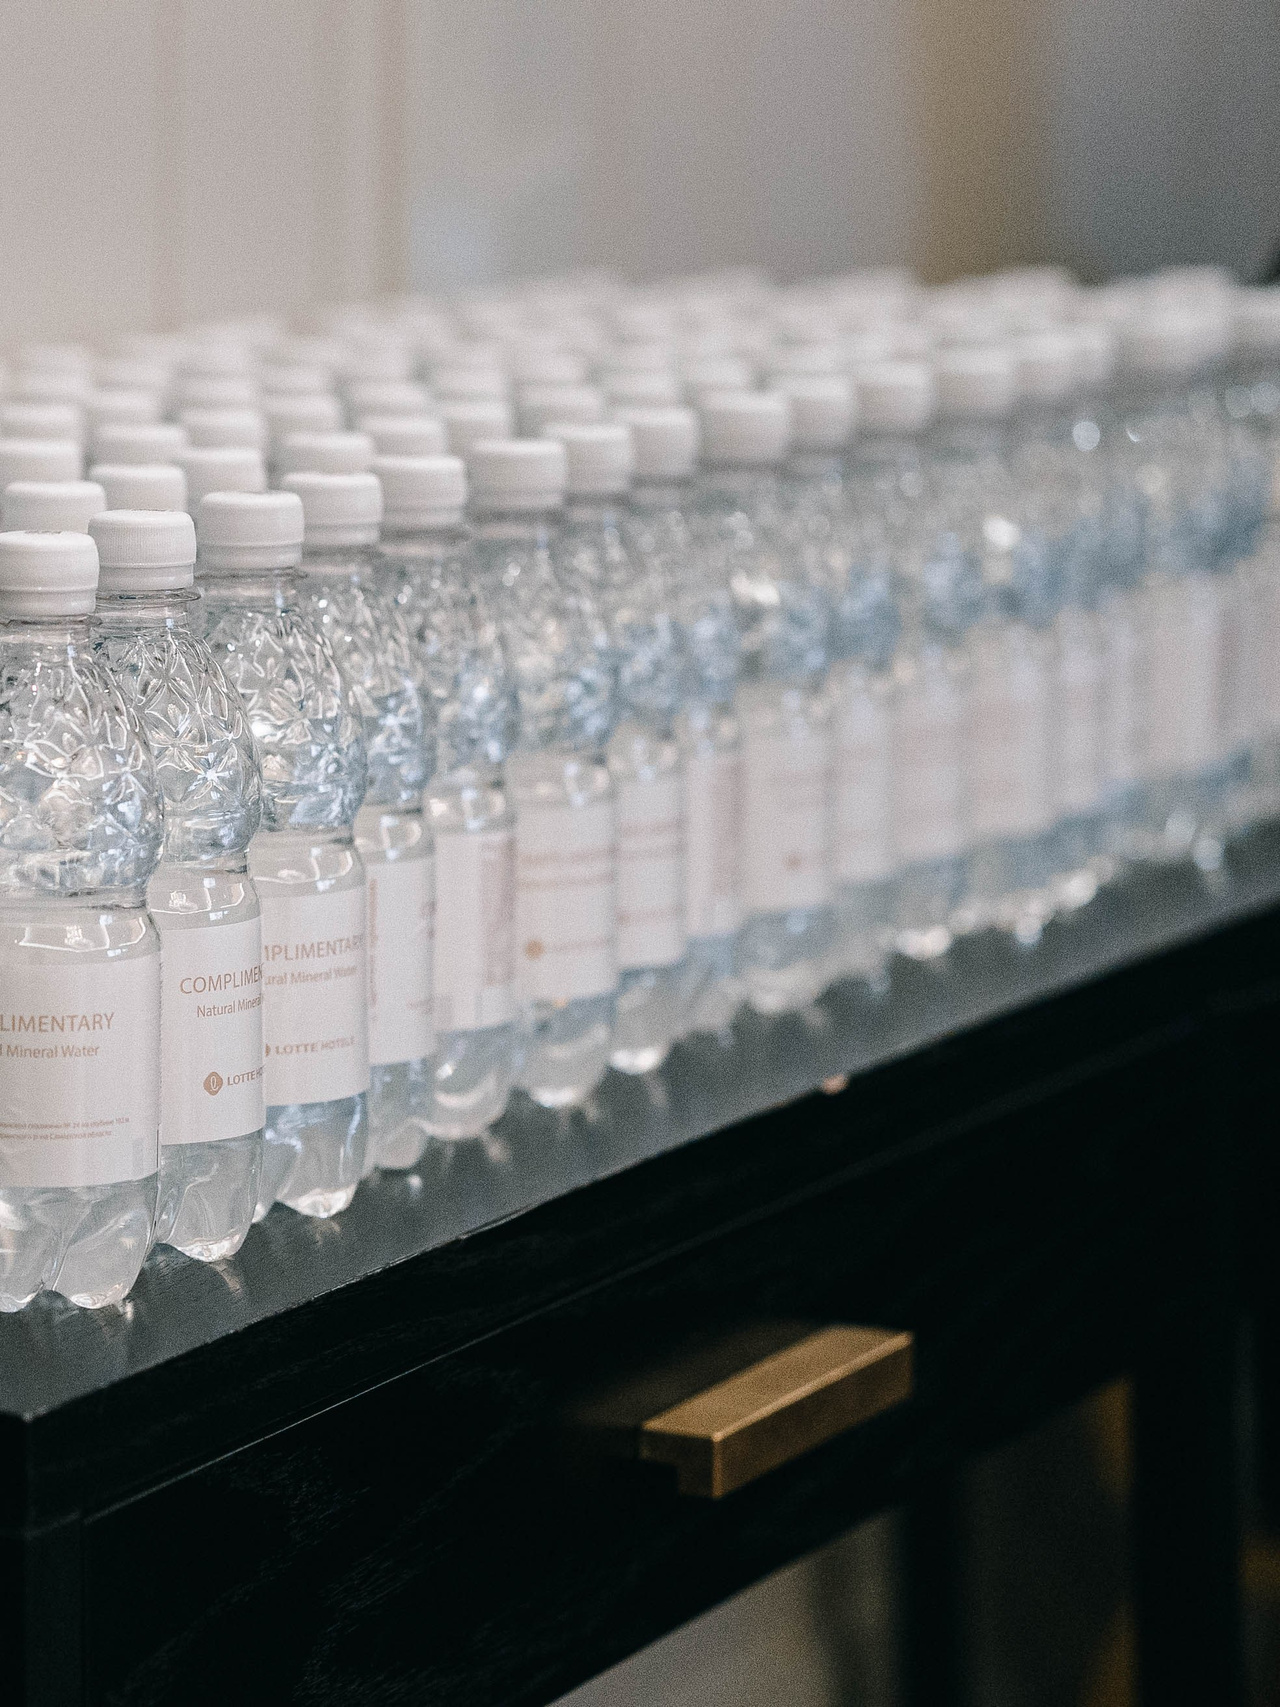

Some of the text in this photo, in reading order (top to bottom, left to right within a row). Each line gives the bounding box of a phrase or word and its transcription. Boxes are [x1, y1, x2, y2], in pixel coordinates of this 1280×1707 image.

[264, 933, 364, 962] PLIMENTARY
[196, 1000, 236, 1018] Natural
[6, 1043, 58, 1059] Mineral
[62, 1045, 100, 1058] Water
[227, 1070, 255, 1086] LOTTE
